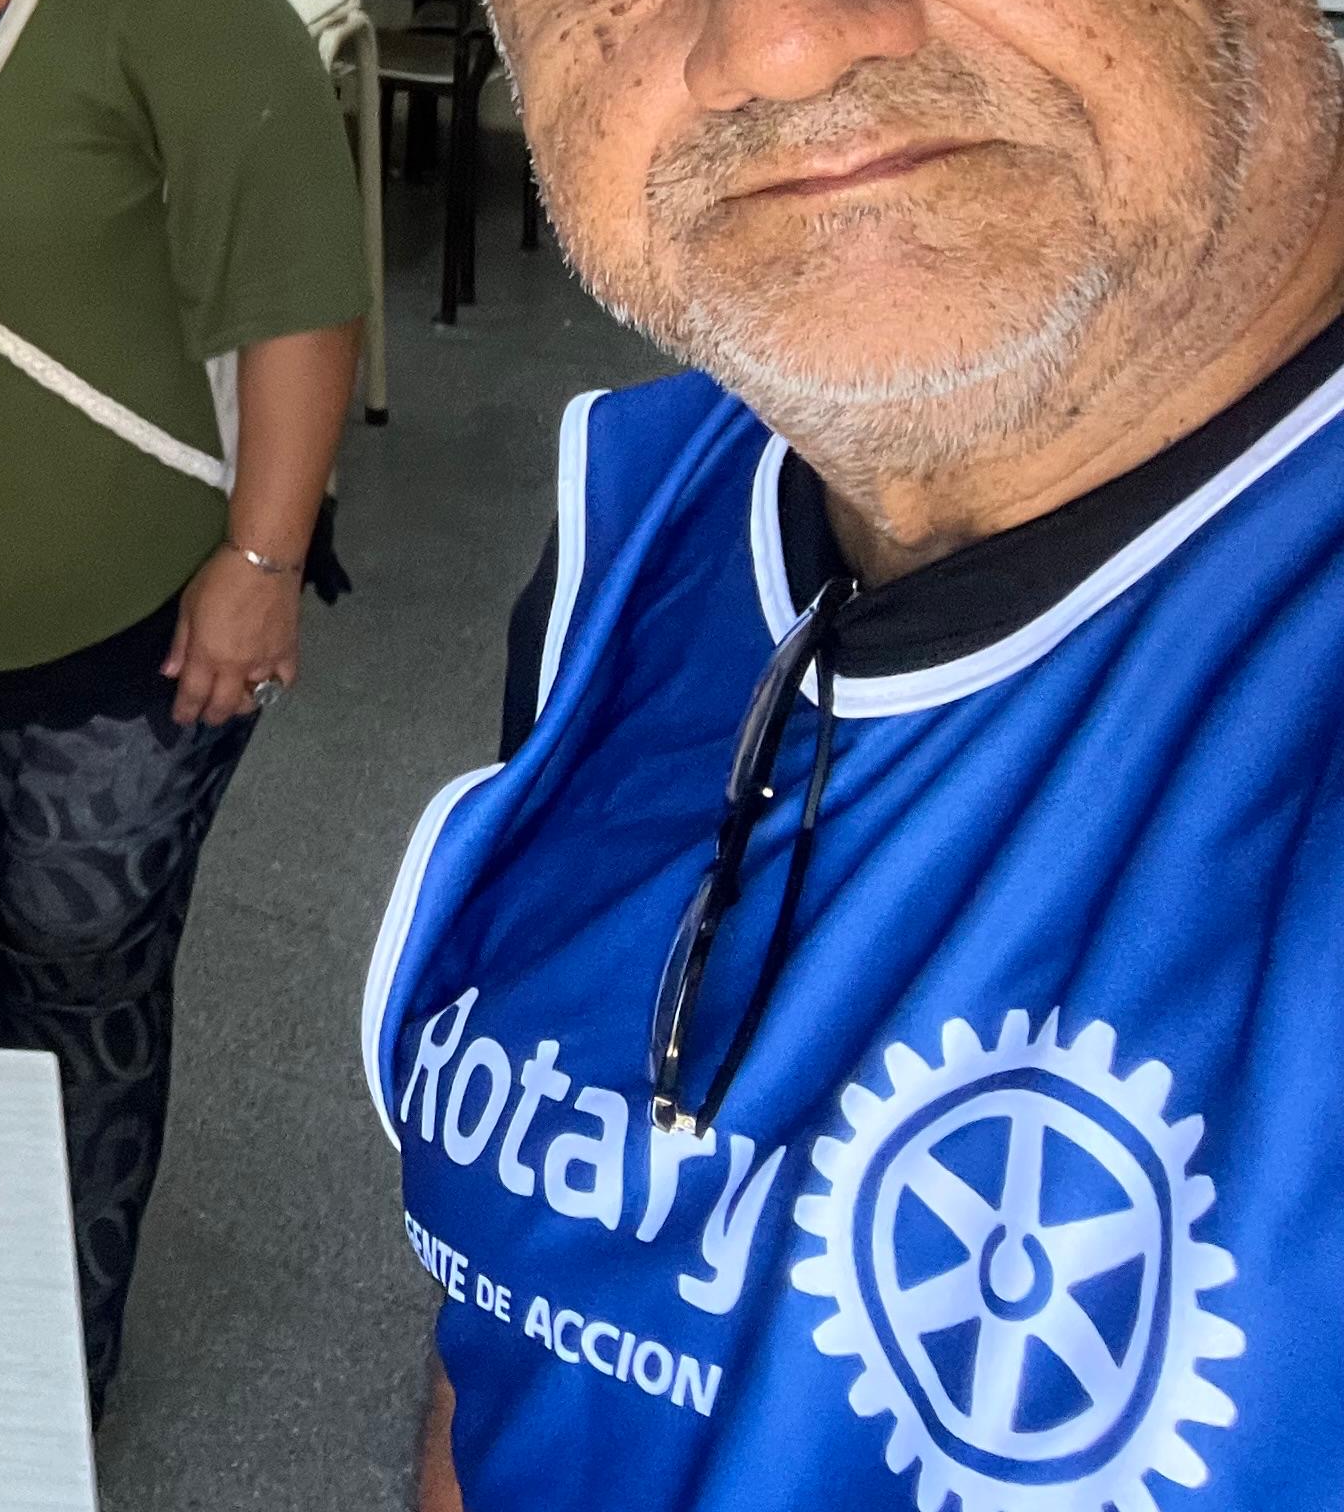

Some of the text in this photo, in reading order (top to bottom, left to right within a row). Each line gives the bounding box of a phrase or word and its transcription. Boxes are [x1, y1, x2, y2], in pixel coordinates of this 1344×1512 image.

[400, 986, 788, 1317] Rotary
[475, 1273, 512, 1324] DE
[524, 1294, 724, 1418] ACCION
